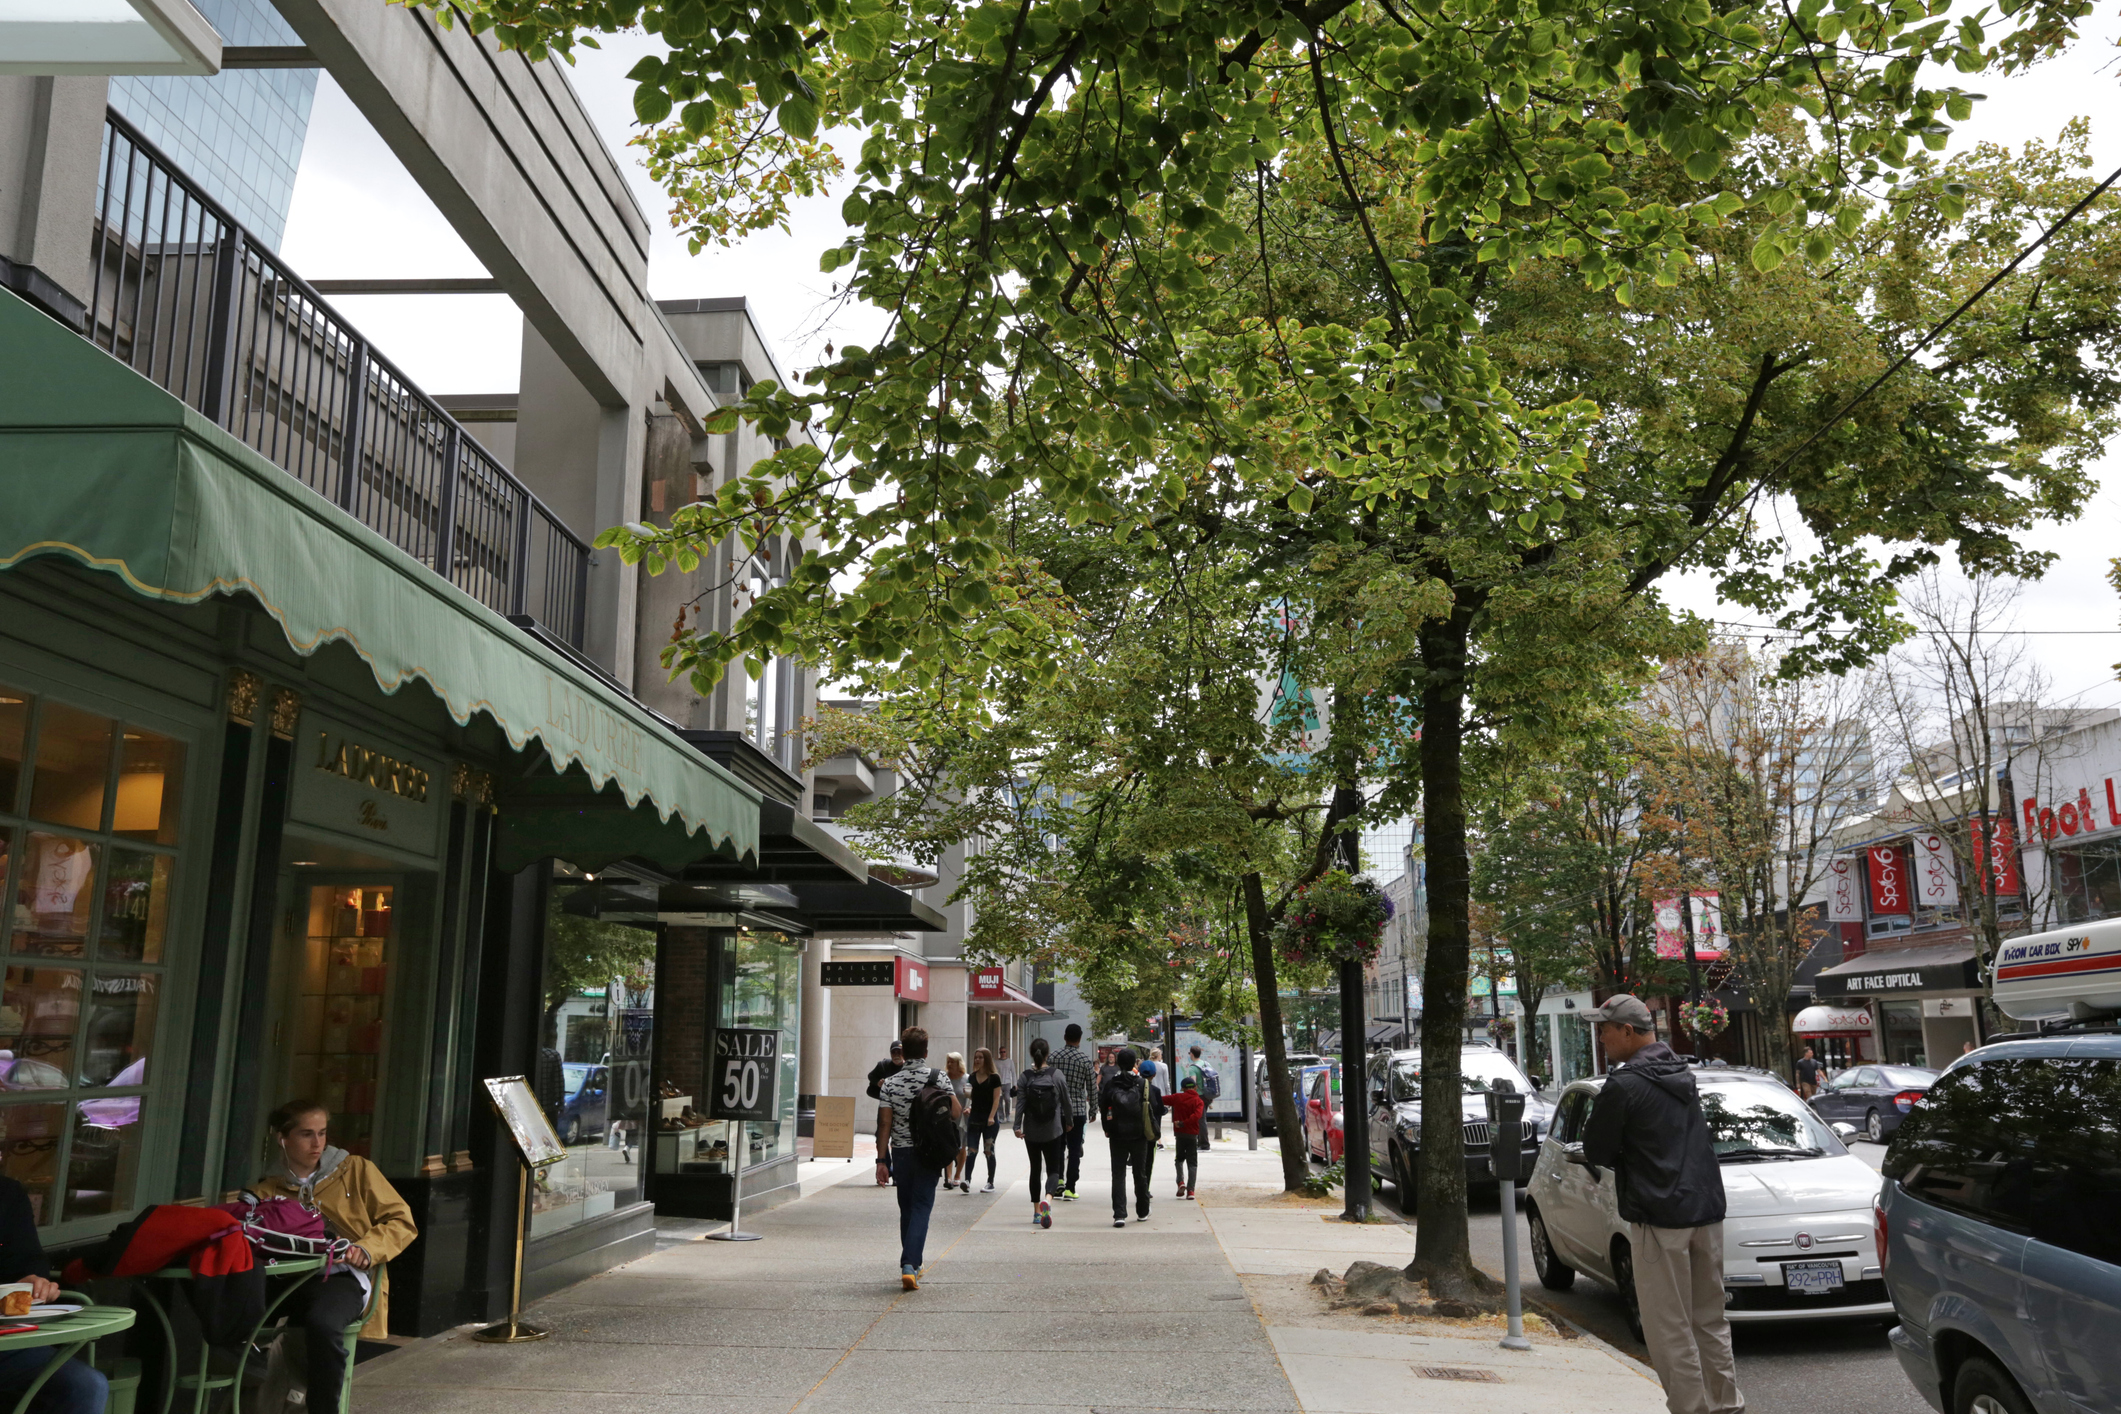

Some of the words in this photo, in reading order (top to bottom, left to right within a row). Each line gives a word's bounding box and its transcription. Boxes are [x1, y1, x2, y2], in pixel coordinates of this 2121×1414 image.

[2023, 787, 2097, 844] Foot
[1920, 835, 1948, 897] Spicy6
[1829, 860, 1854, 915] Spicy6
[1873, 848, 1900, 907] Spicy6
[2029, 944, 2043, 957] CAR
[2044, 942, 2062, 956] BOX
[2066, 937, 2083, 952] SPY
[827, 964, 889, 972] BAILEY
[826, 976, 890, 984] NELSON
[978, 975, 999, 984] MUJI
[1846, 977, 1862, 991] ART
[1864, 975, 1884, 990] FACE
[1885, 972, 1923, 988] OPTICAL
[1827, 1012, 1870, 1028] Spicy6
[716, 1032, 775, 1058] SALE
[722, 1060, 760, 1109] 50
[1787, 1272, 1812, 1288] 292
[1817, 1270, 1842, 1286] PRH
